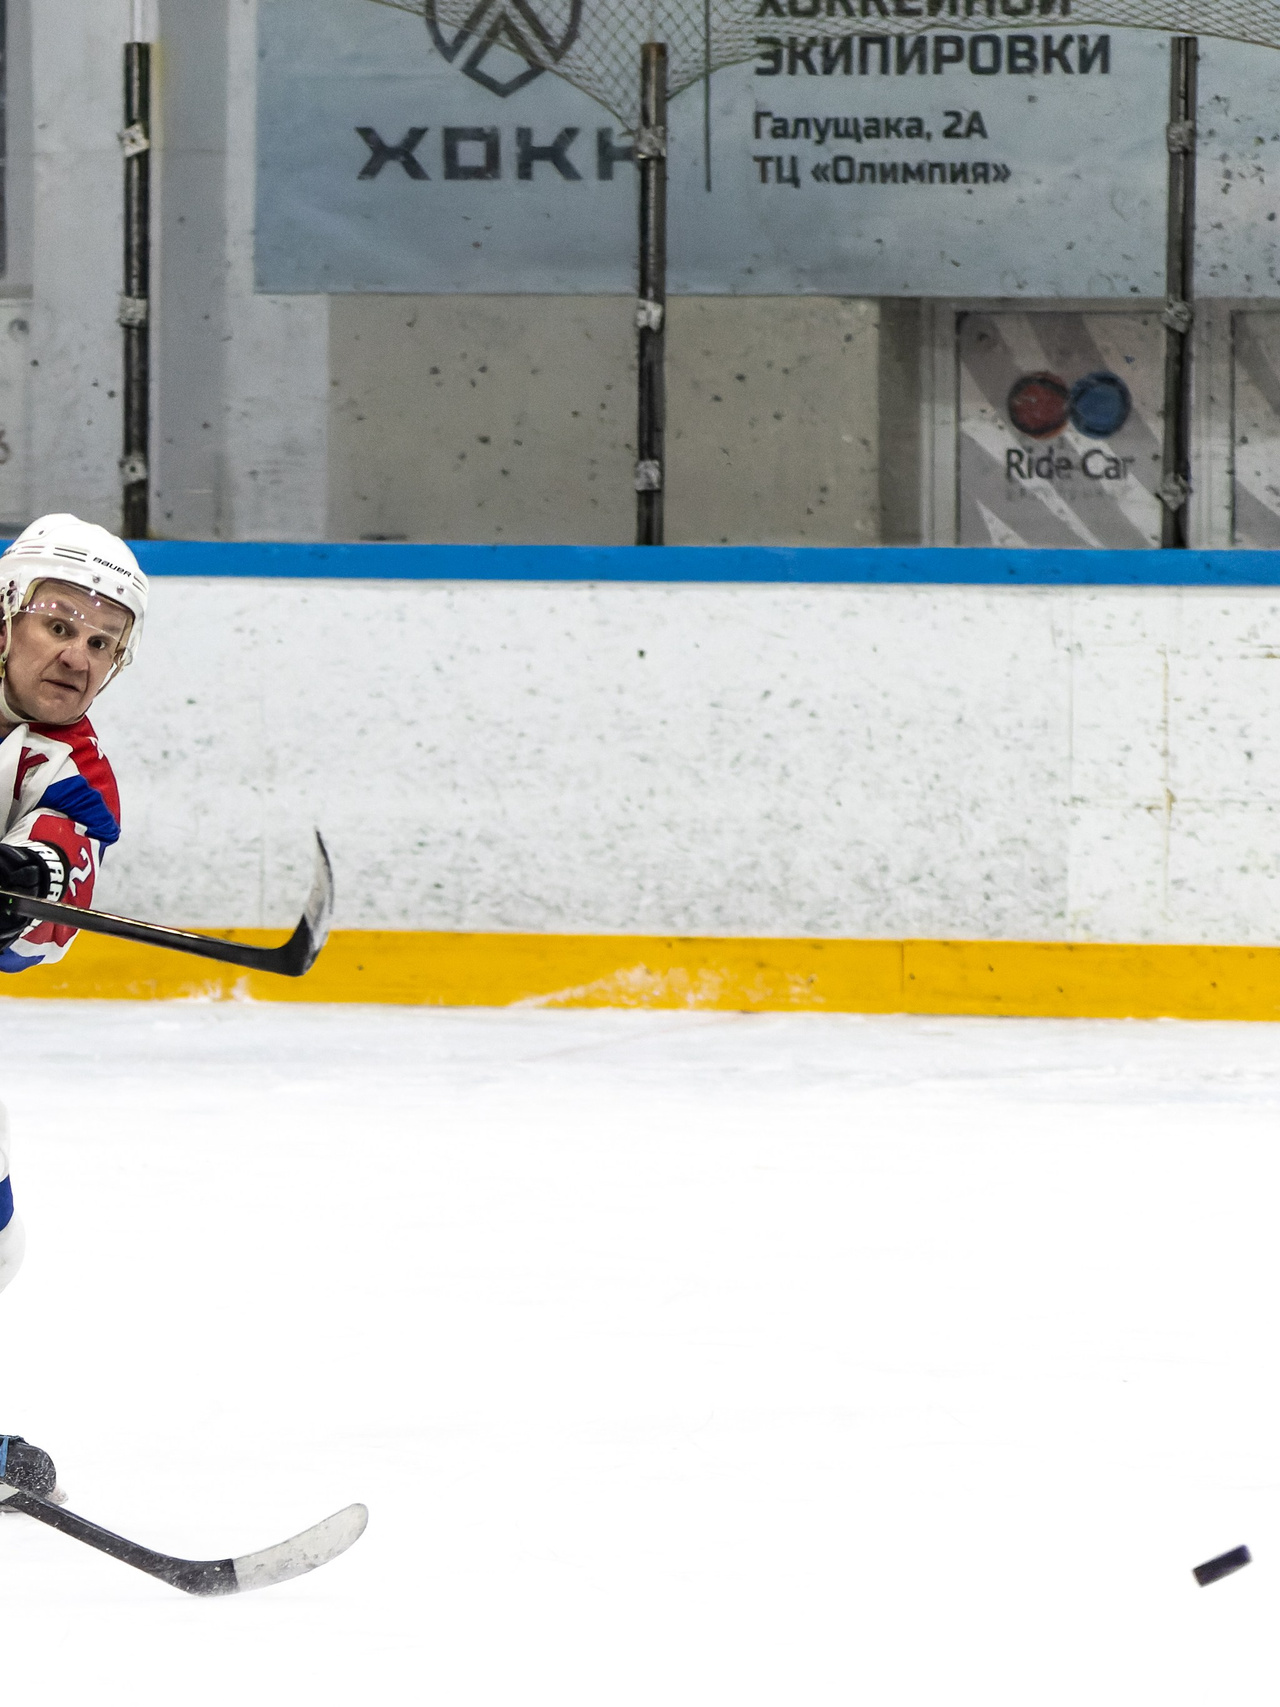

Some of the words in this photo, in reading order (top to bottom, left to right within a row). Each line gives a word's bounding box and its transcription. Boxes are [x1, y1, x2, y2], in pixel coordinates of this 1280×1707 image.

[754, 34, 1111, 76] ЭКИПИРОВКИ
[754, 110, 933, 145] Галущака,
[753, 155, 801, 188] ТЦ
[810, 154, 1012, 185] «Олимпия»
[1006, 445, 1074, 481] Ride
[1081, 447, 1136, 480] Car
